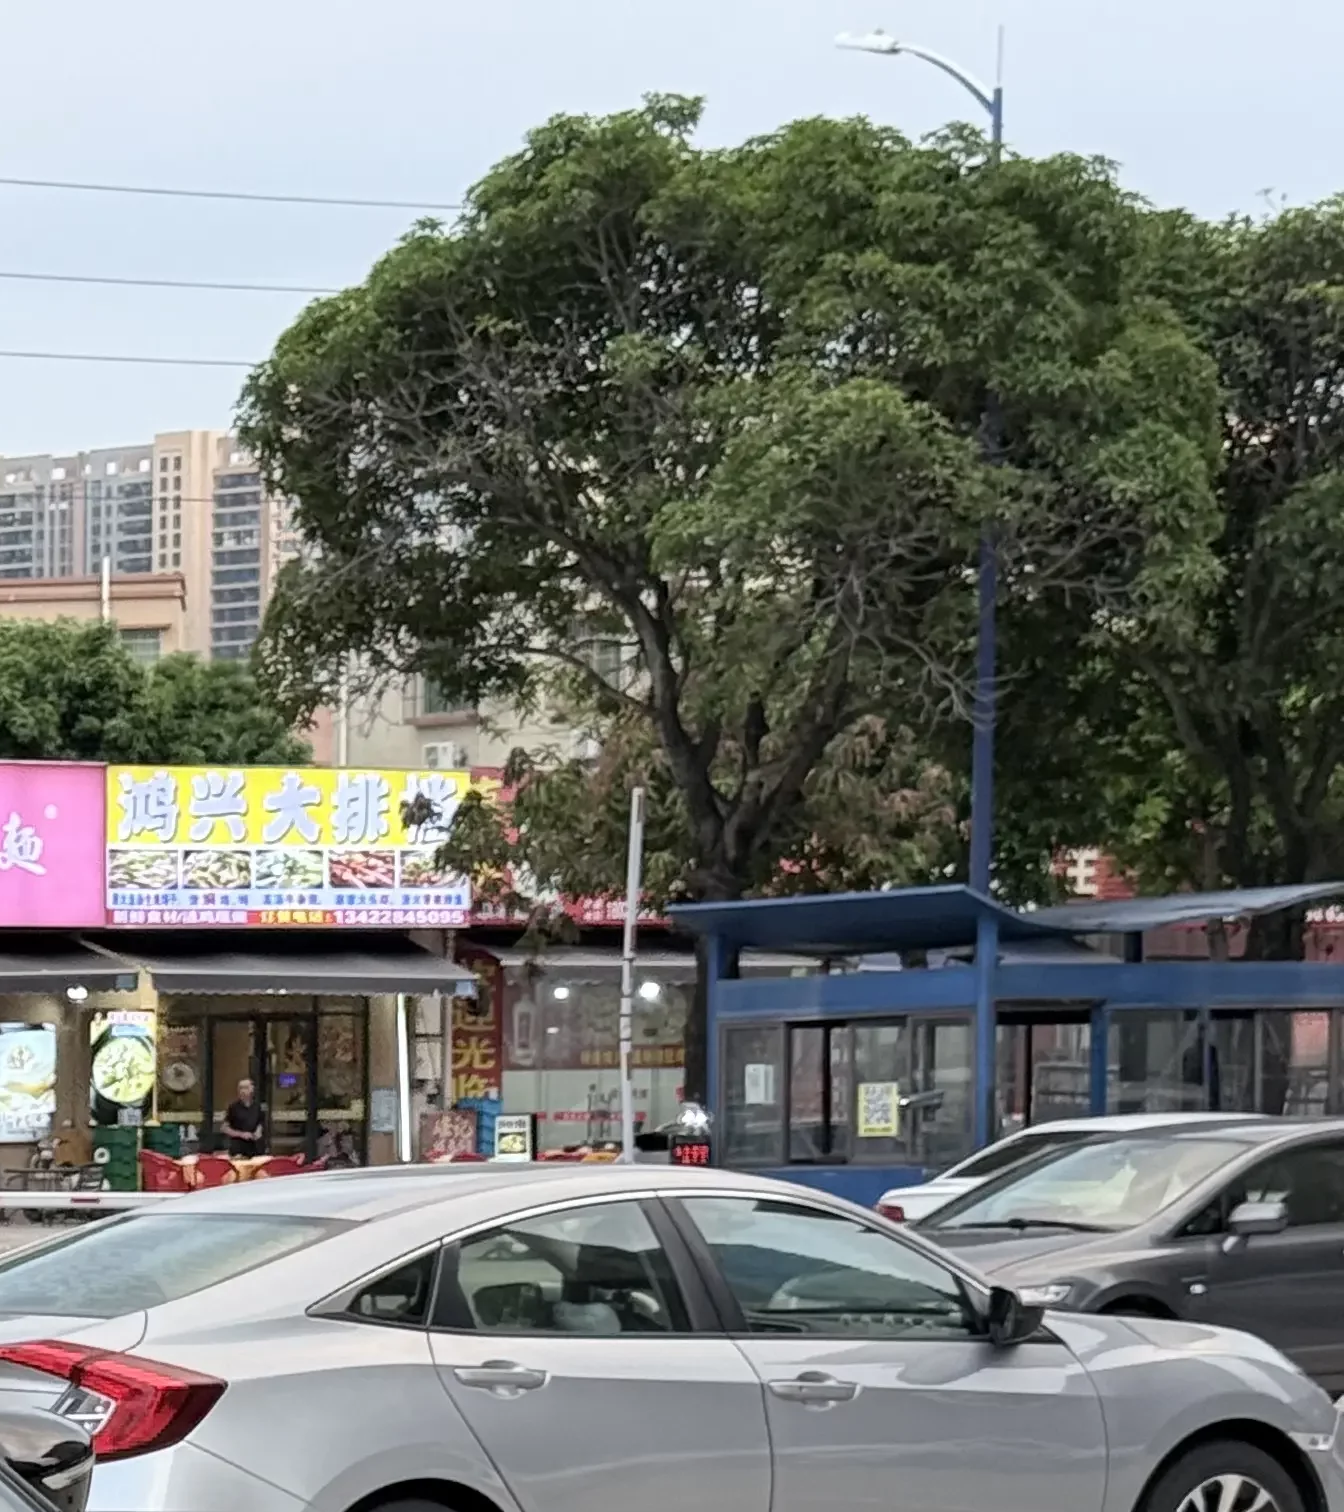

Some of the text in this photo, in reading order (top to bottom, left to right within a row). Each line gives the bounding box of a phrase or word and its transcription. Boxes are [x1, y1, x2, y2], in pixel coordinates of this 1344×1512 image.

[116, 770, 458, 845] 鸿兴大排档
